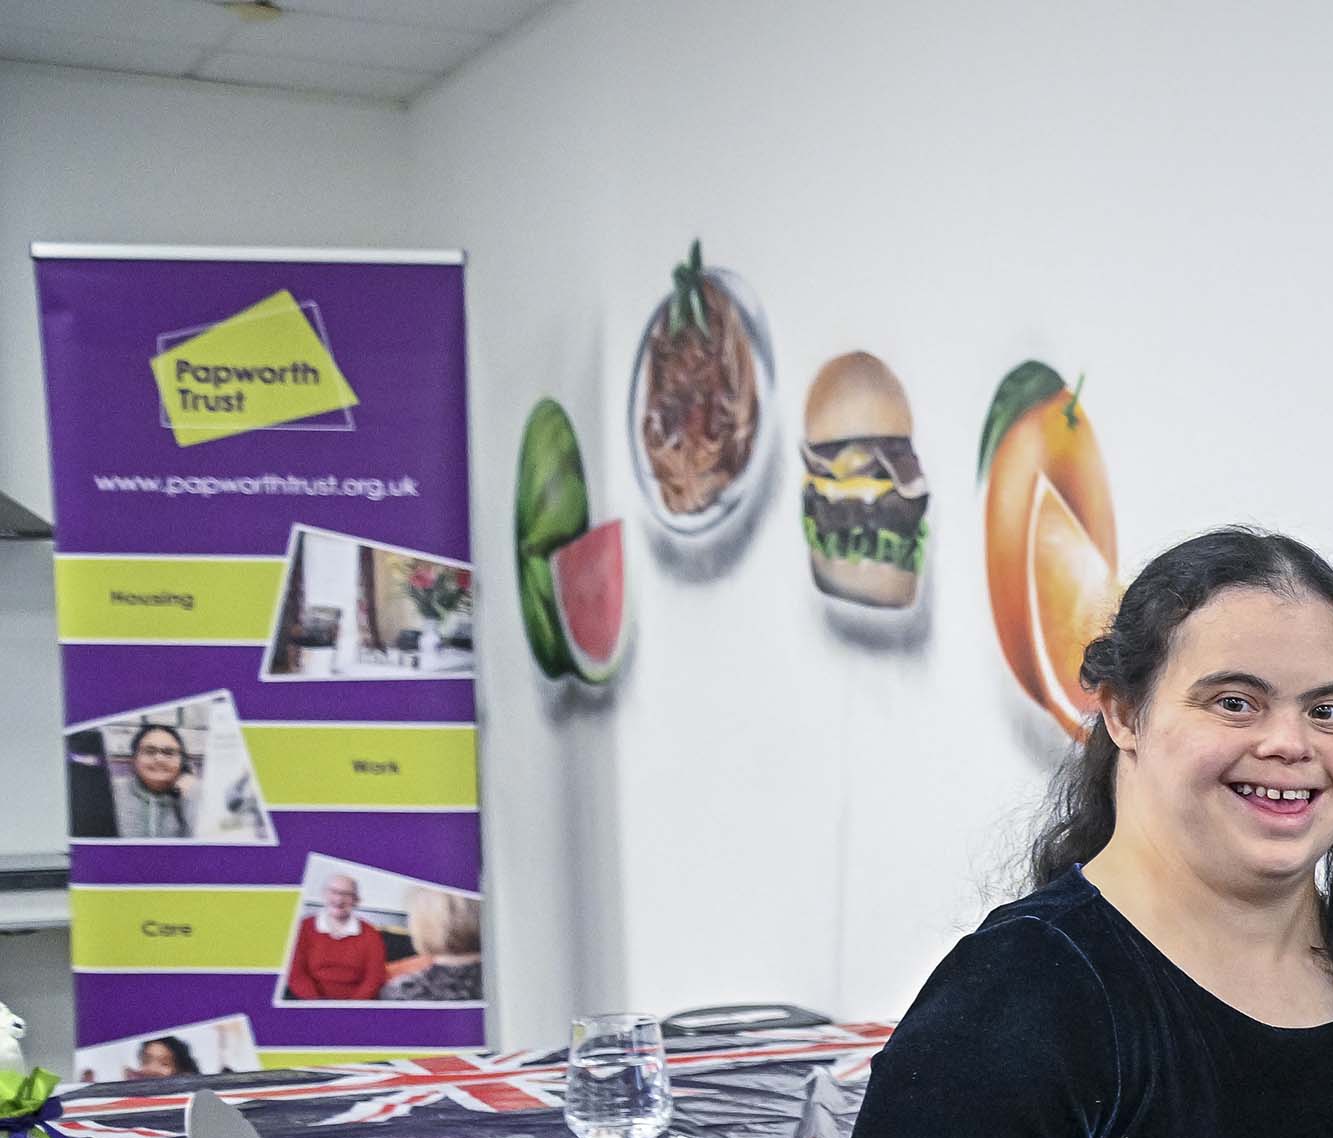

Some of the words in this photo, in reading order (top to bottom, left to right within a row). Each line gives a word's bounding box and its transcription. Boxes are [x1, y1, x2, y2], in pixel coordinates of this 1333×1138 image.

[176, 359, 320, 388] Papworth
[178, 387, 246, 413] Trust
[94, 474, 420, 501] www.papworthtrust.org.uk
[110, 590, 194, 611] Housing
[351, 758, 400, 776] Work
[141, 919, 192, 938] Care
